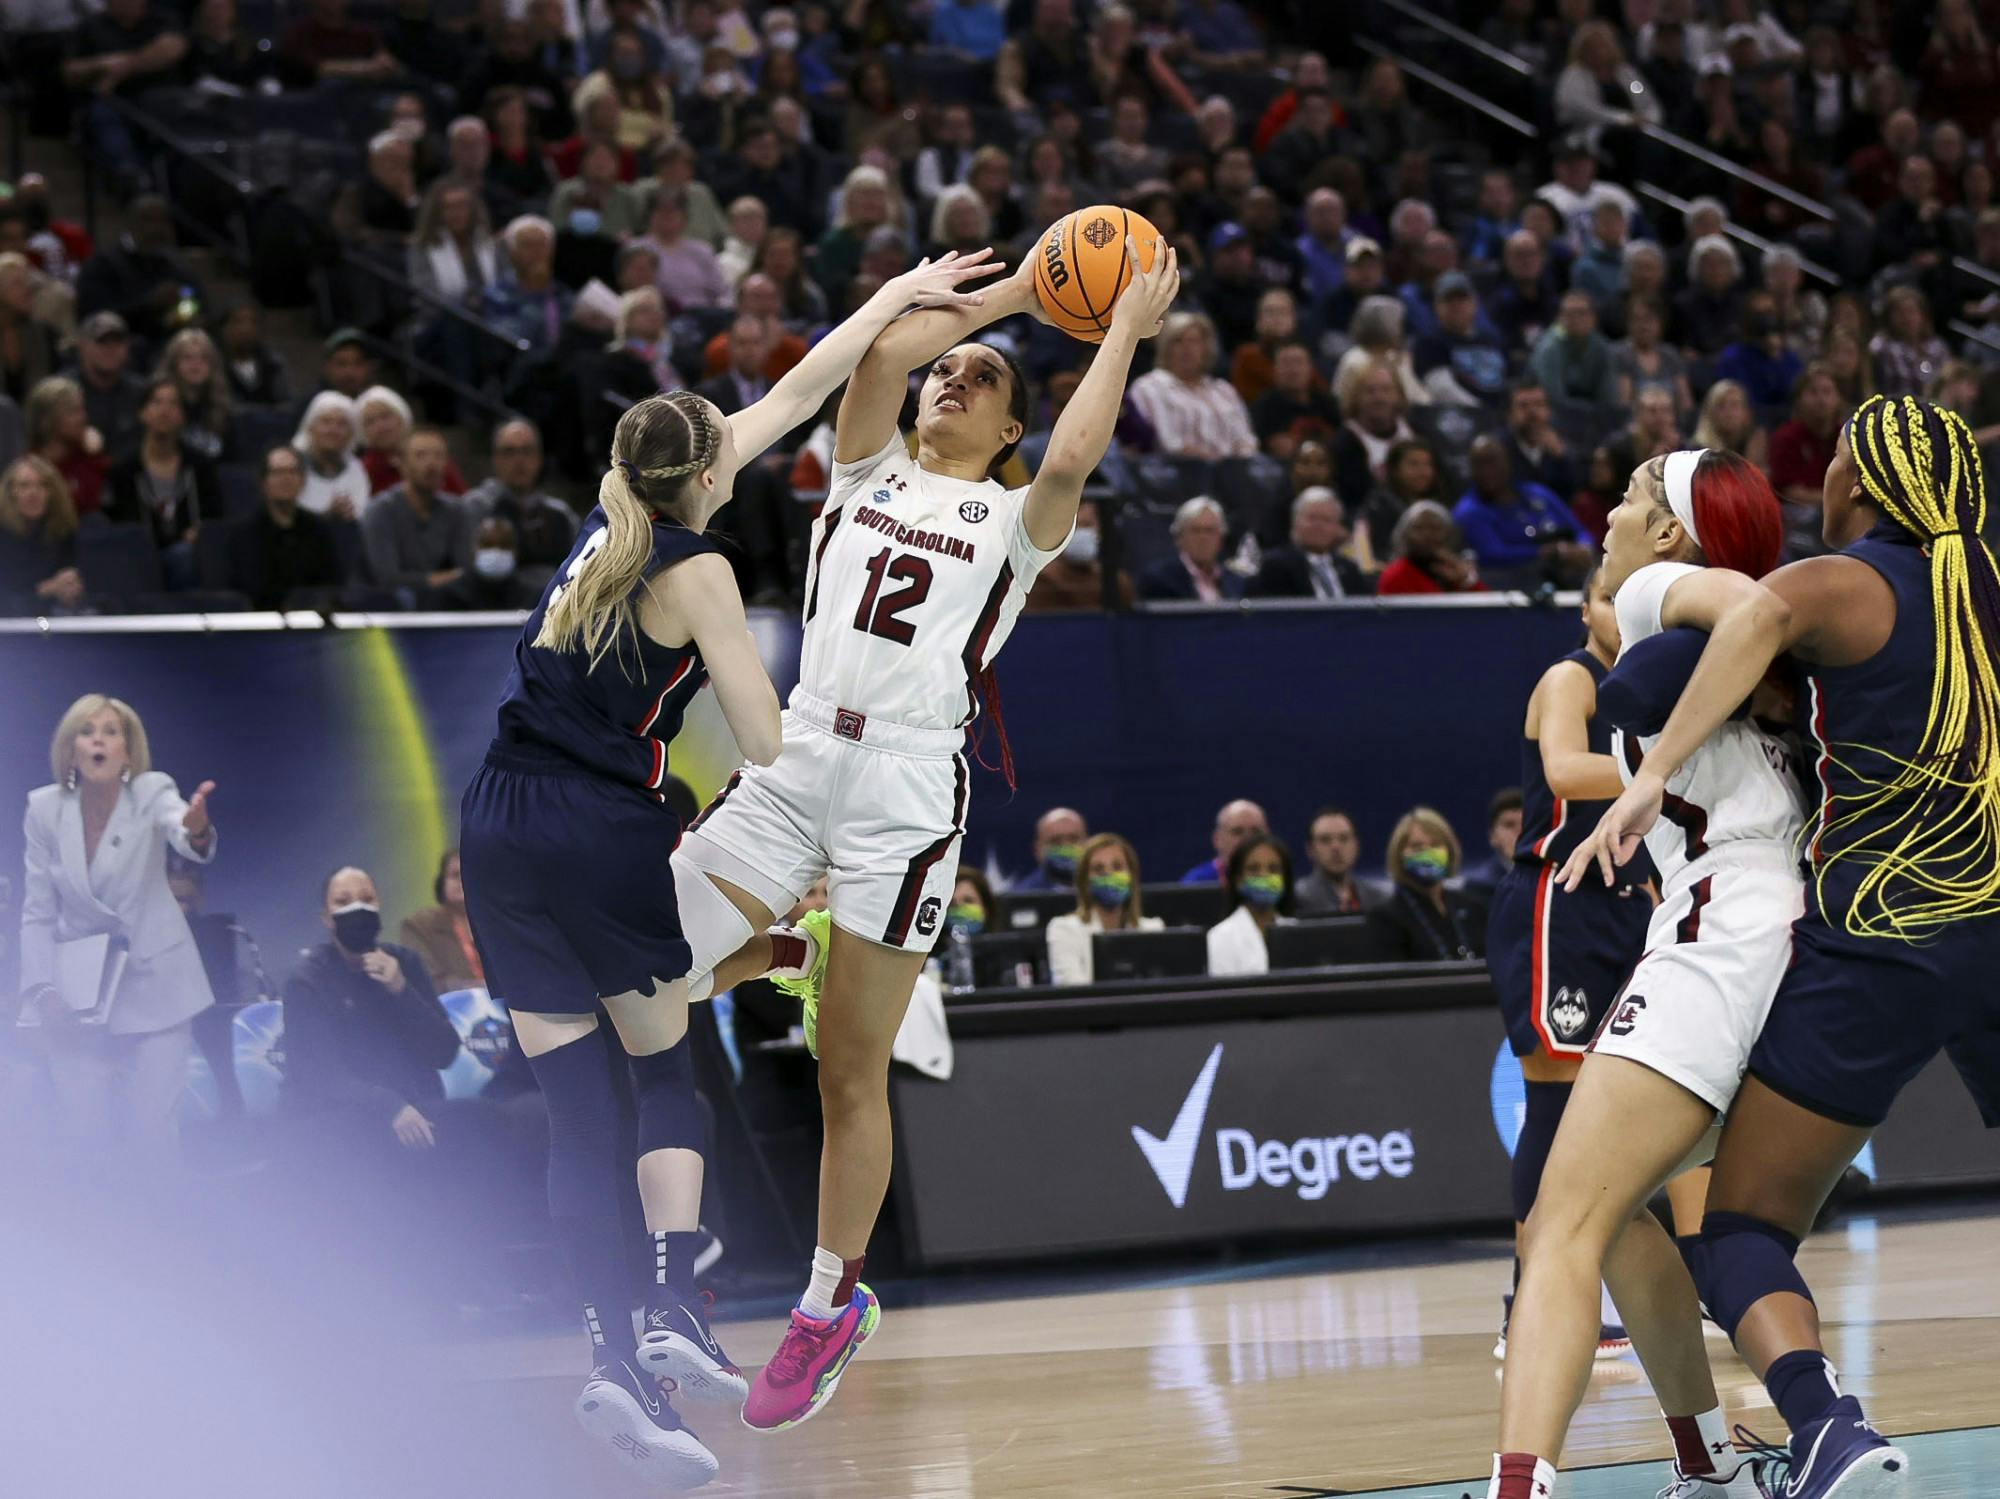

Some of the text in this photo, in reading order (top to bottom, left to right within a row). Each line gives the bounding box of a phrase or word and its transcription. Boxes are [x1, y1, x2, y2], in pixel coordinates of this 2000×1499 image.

[853, 505, 976, 564] SOUTH CAROLINA
[960, 502, 987, 522] SEC
[853, 546, 934, 647] 12
[1216, 1127, 1415, 1200] Degree
